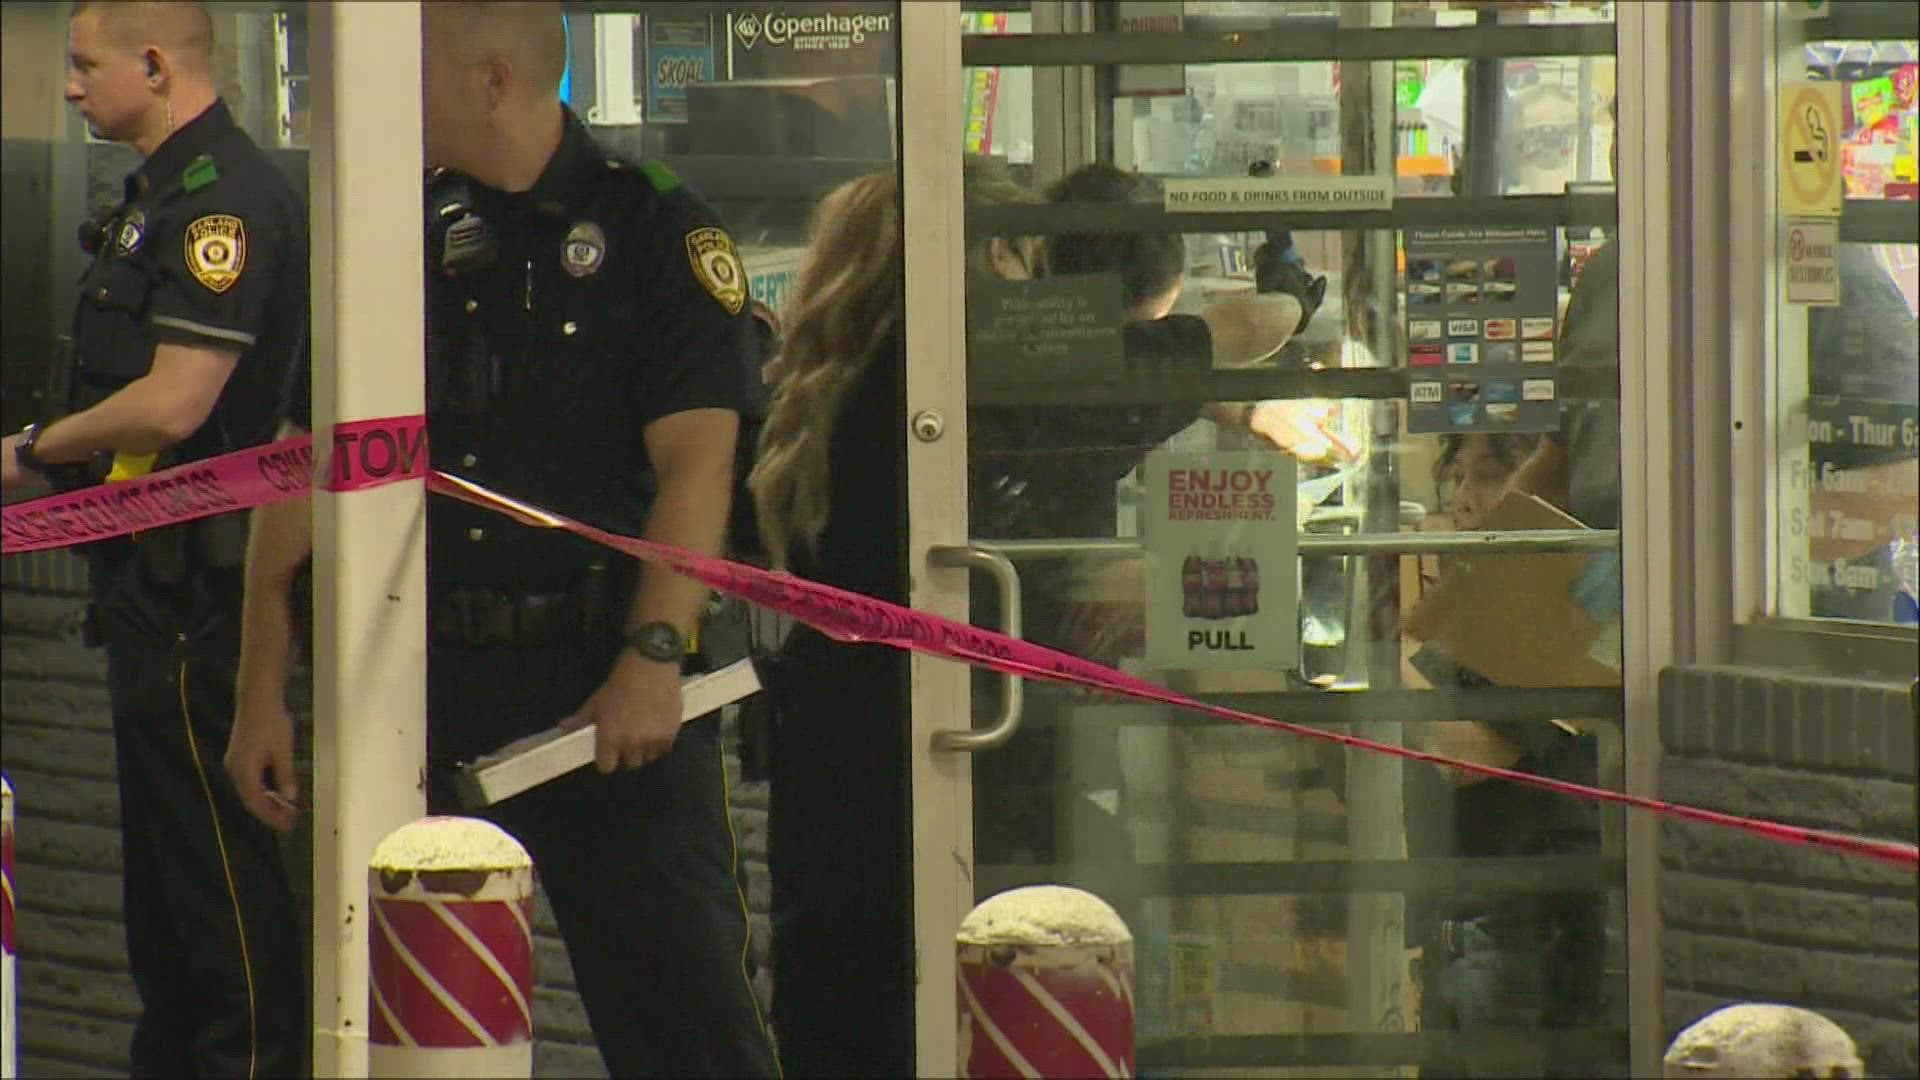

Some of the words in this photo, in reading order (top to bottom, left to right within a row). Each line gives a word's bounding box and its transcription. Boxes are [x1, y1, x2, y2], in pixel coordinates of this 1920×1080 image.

[764, 13, 889, 43] Copenhagen
[658, 55, 704, 88] SKOAL
[1170, 191, 1189, 201] NO
[1192, 191, 1227, 201] FOOD
[1244, 190, 1289, 201] DRINKS
[1293, 190, 1330, 201] FROM
[1333, 189, 1385, 201] OUTSIDE
[1451, 322, 1476, 337] VISA
[1413, 386, 1440, 399] ATM
[1848, 415, 1896, 446] Thur
[147, 469, 237, 518] CROSS
[257, 447, 314, 493] CRIM
[1168, 469, 1274, 492] ENJOY
[1168, 493, 1275, 510] ENDLESS
[1168, 510, 1276, 521] REFRESHMENT.
[1188, 631, 1255, 651] PULL
